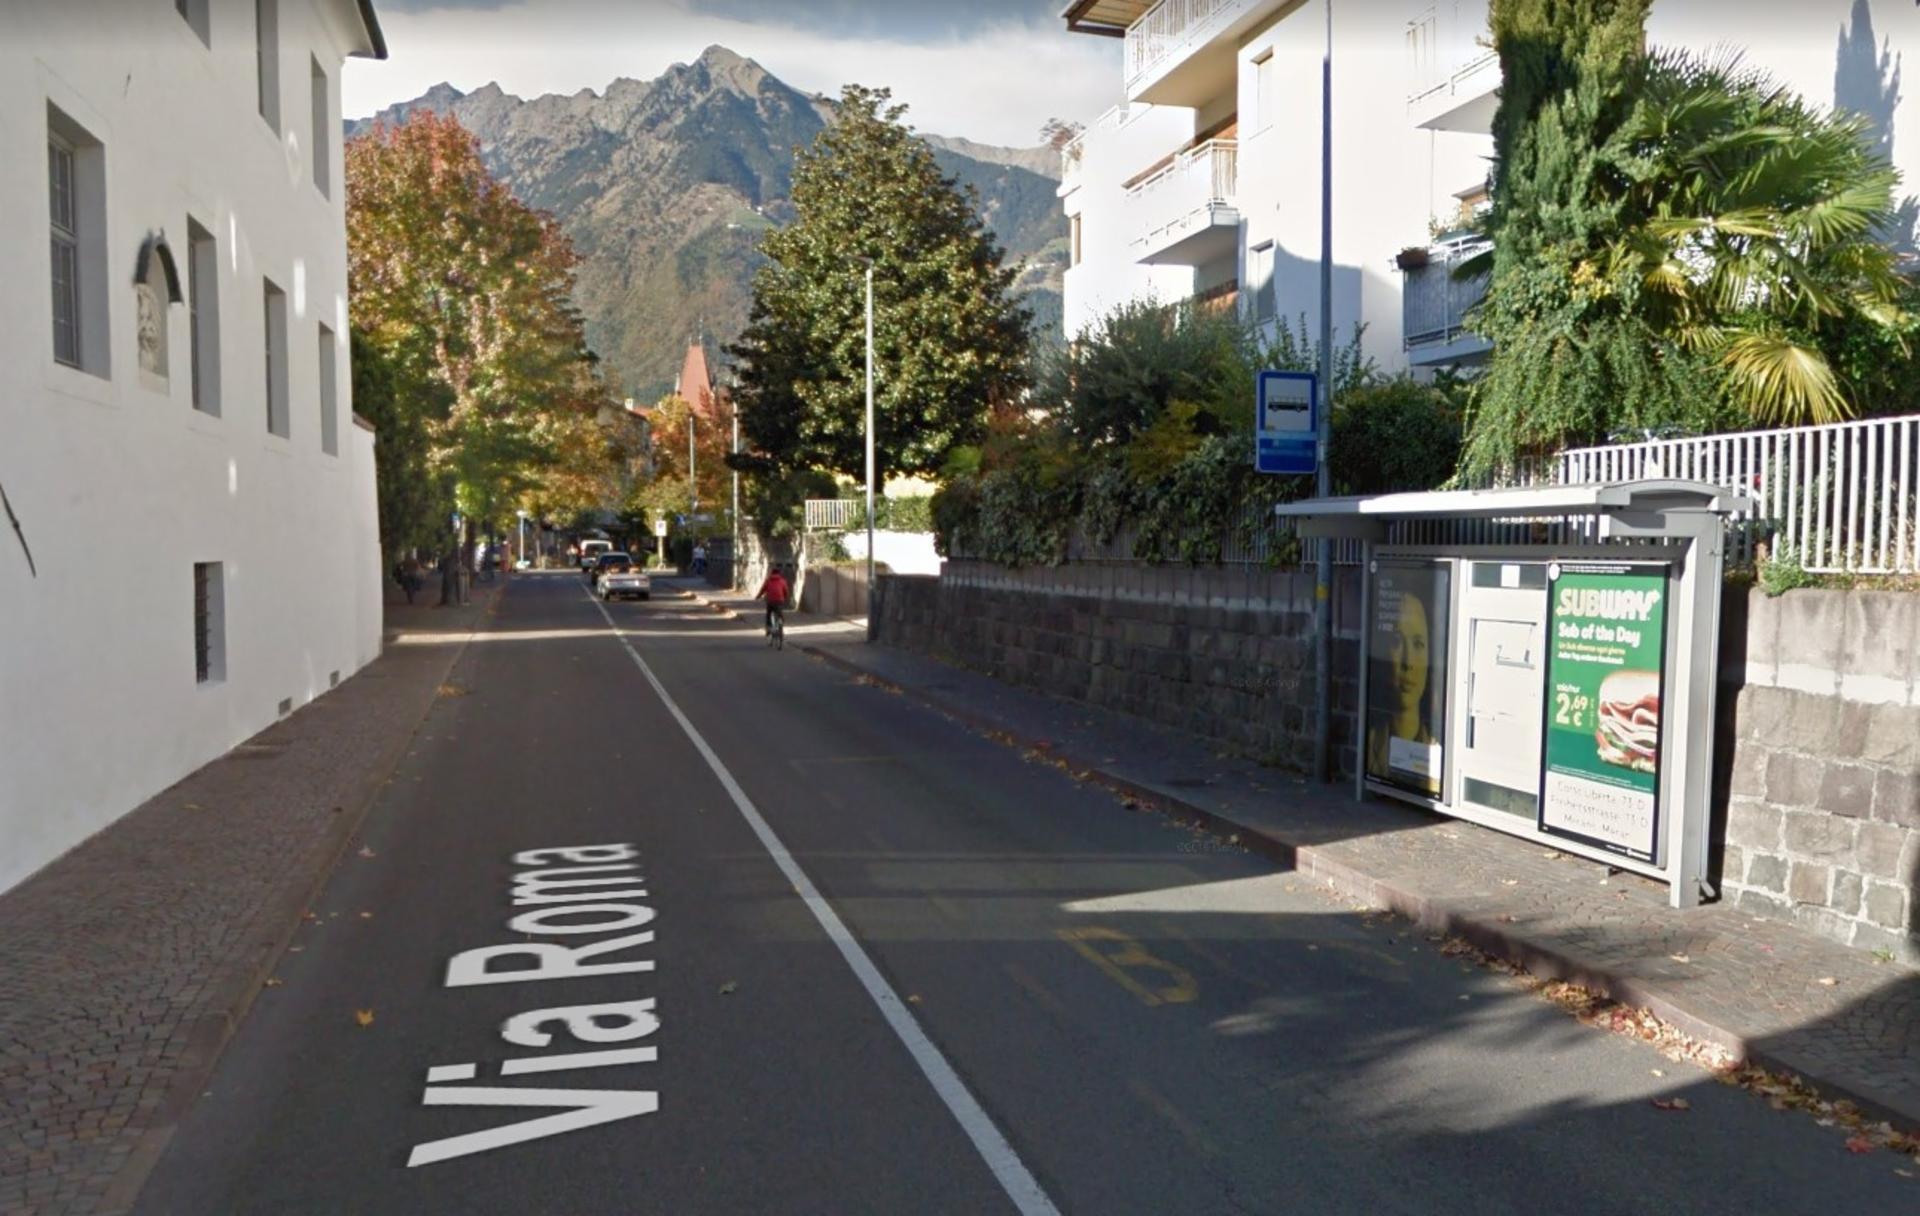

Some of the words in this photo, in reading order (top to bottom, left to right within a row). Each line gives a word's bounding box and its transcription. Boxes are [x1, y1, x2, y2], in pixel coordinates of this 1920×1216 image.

[1556, 588, 1661, 621] SUBWAY
[1558, 622, 1579, 638] Sub
[1581, 623, 1595, 639] of
[1596, 626, 1615, 642] the
[1616, 627, 1640, 648] Day
